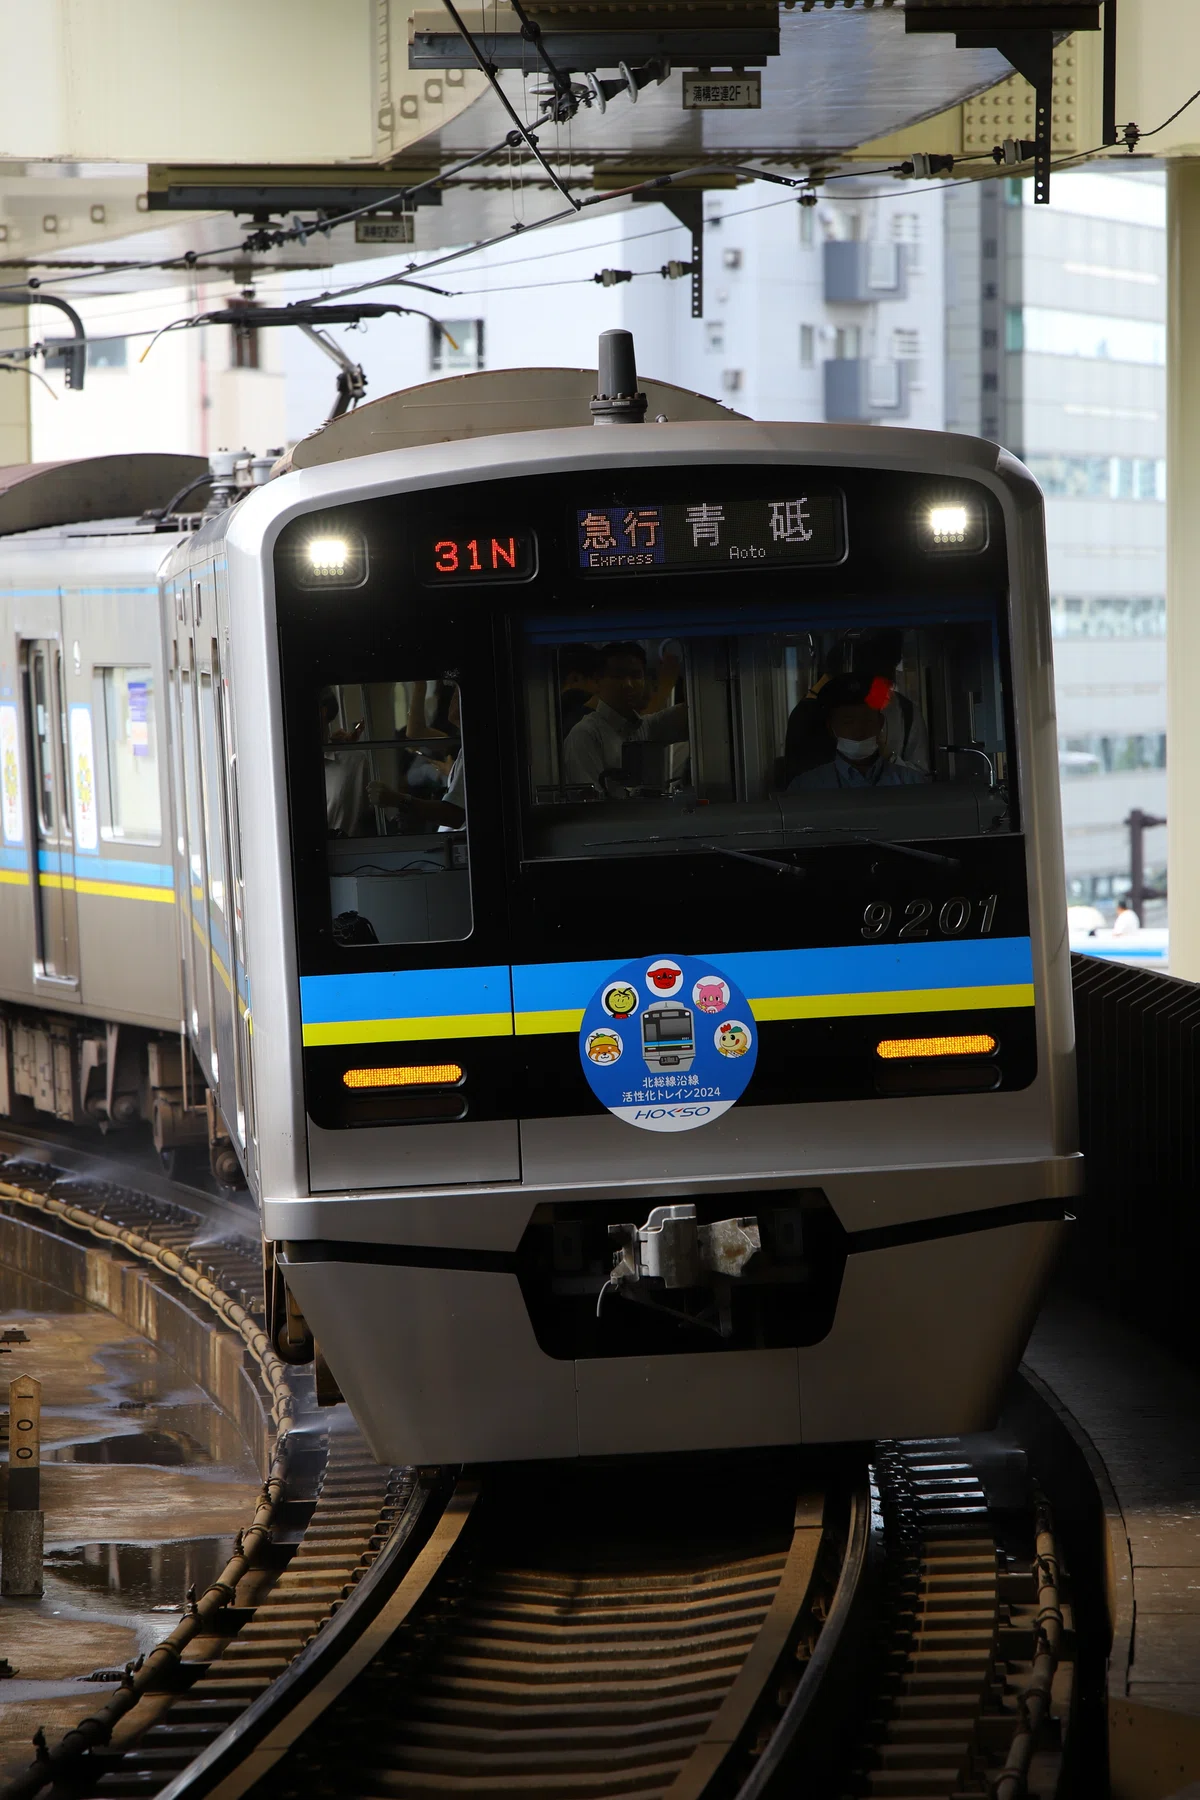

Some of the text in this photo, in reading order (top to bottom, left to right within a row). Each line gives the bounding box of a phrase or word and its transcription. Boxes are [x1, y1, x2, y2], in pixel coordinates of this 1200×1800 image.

[581, 511, 660, 549] 急行
[686, 498, 813, 547] 青砥
[435, 538, 516, 571] 31N
[590, 553, 653, 567] Express
[729, 545, 766, 560] Aoto
[860, 894, 998, 939] 9201
[642, 1074, 700, 1089] 北総線沿線
[622, 1087, 721, 1103] 活性化トレイン2024
[635, 1106, 711, 1120] HOKSO
